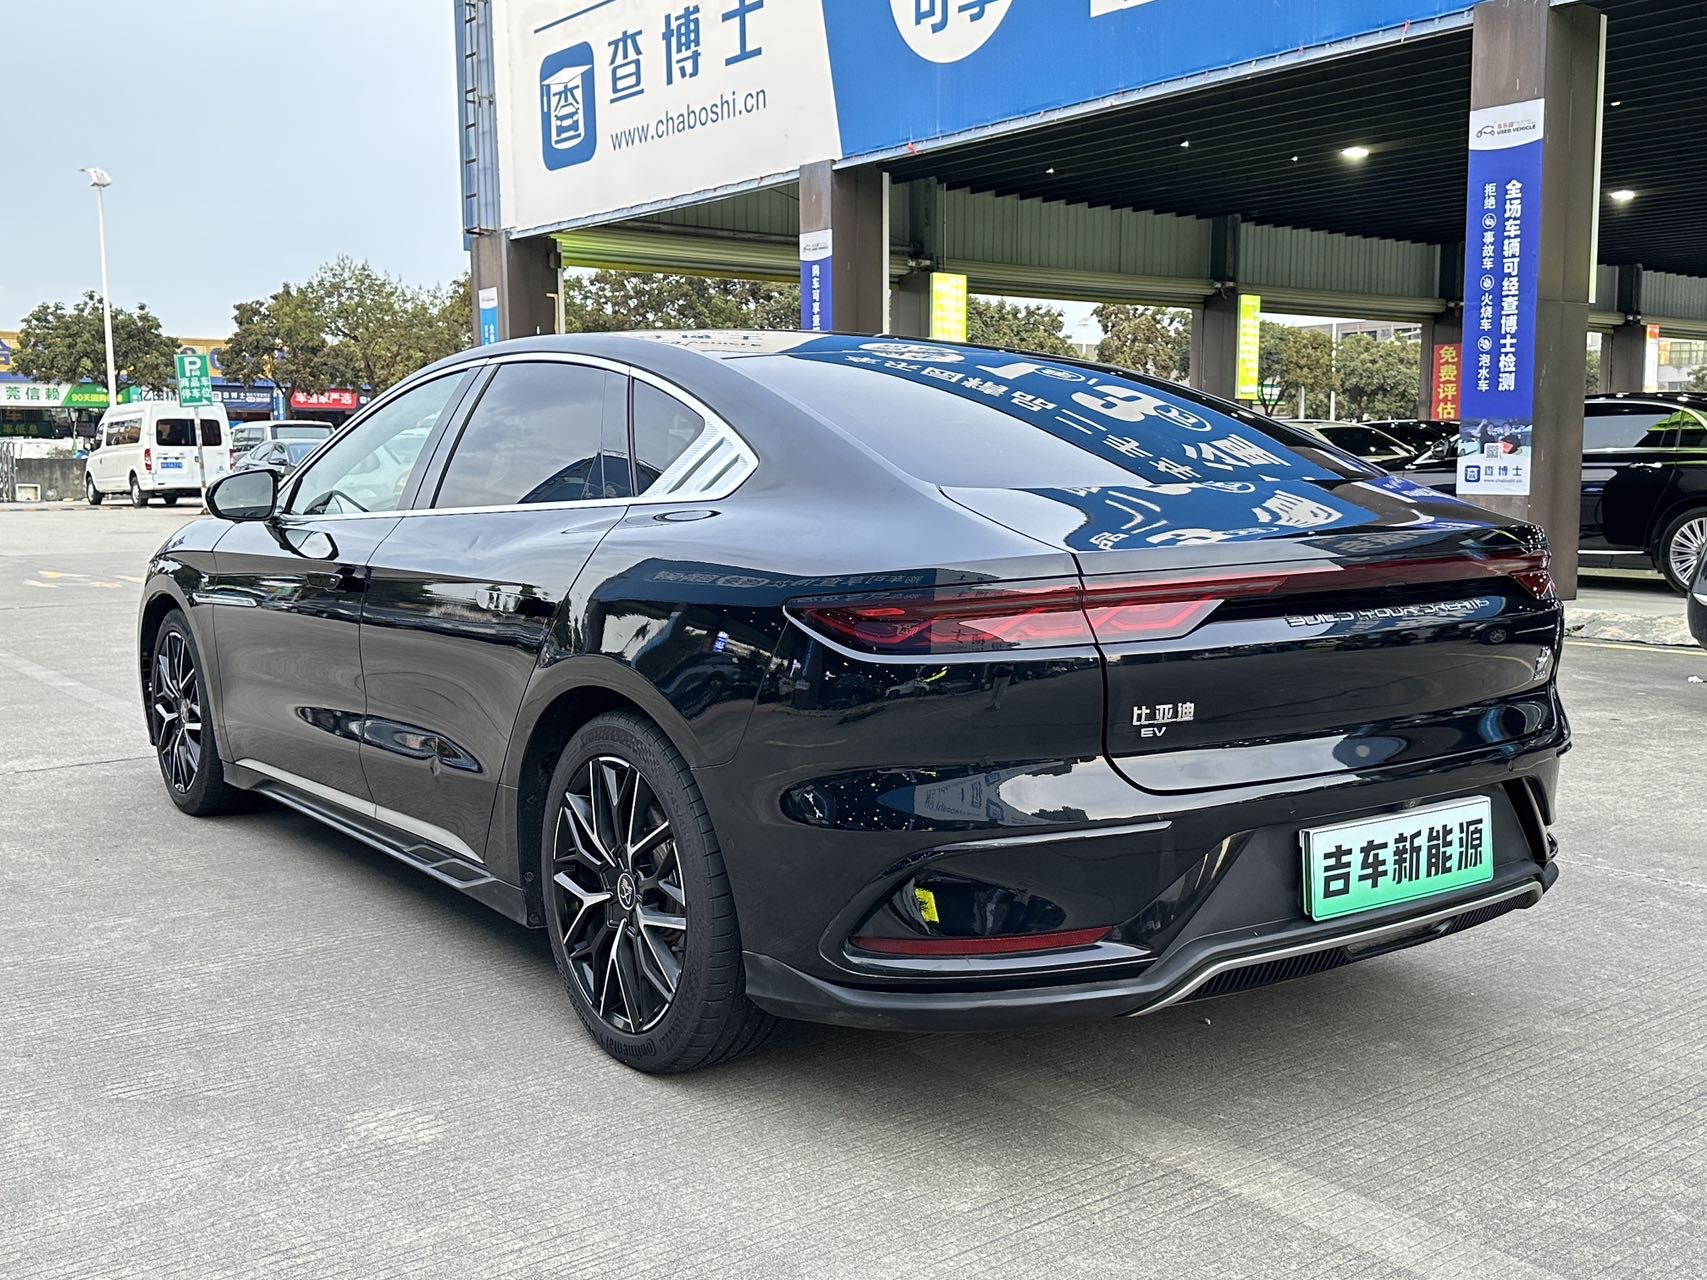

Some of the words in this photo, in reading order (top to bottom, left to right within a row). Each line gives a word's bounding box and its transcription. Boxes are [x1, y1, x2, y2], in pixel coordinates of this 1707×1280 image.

[608, 0, 765, 104] 查博士
[610, 88, 767, 151] www.chaboshi.cn
[1483, 182, 1497, 209] 拒绝
[1481, 231, 1495, 270] 事故车
[1497, 179, 1523, 391] 全场车辆可经查博士检测
[1479, 293, 1493, 331] 火烧车
[181, 377, 211, 387] 商品车
[184, 357, 201, 377] P
[1437, 345, 1458, 419] 免费评估
[1477, 354, 1491, 392] 泡水车
[181, 388, 212, 399] 停车位
[1285, 612, 1354, 627] BUILD
[1357, 605, 1418, 621] YOUR
[1132, 702, 1194, 726] 比亚迪
[1141, 727, 1167, 738] EV
[1322, 817, 1484, 900] 吉车新能源
